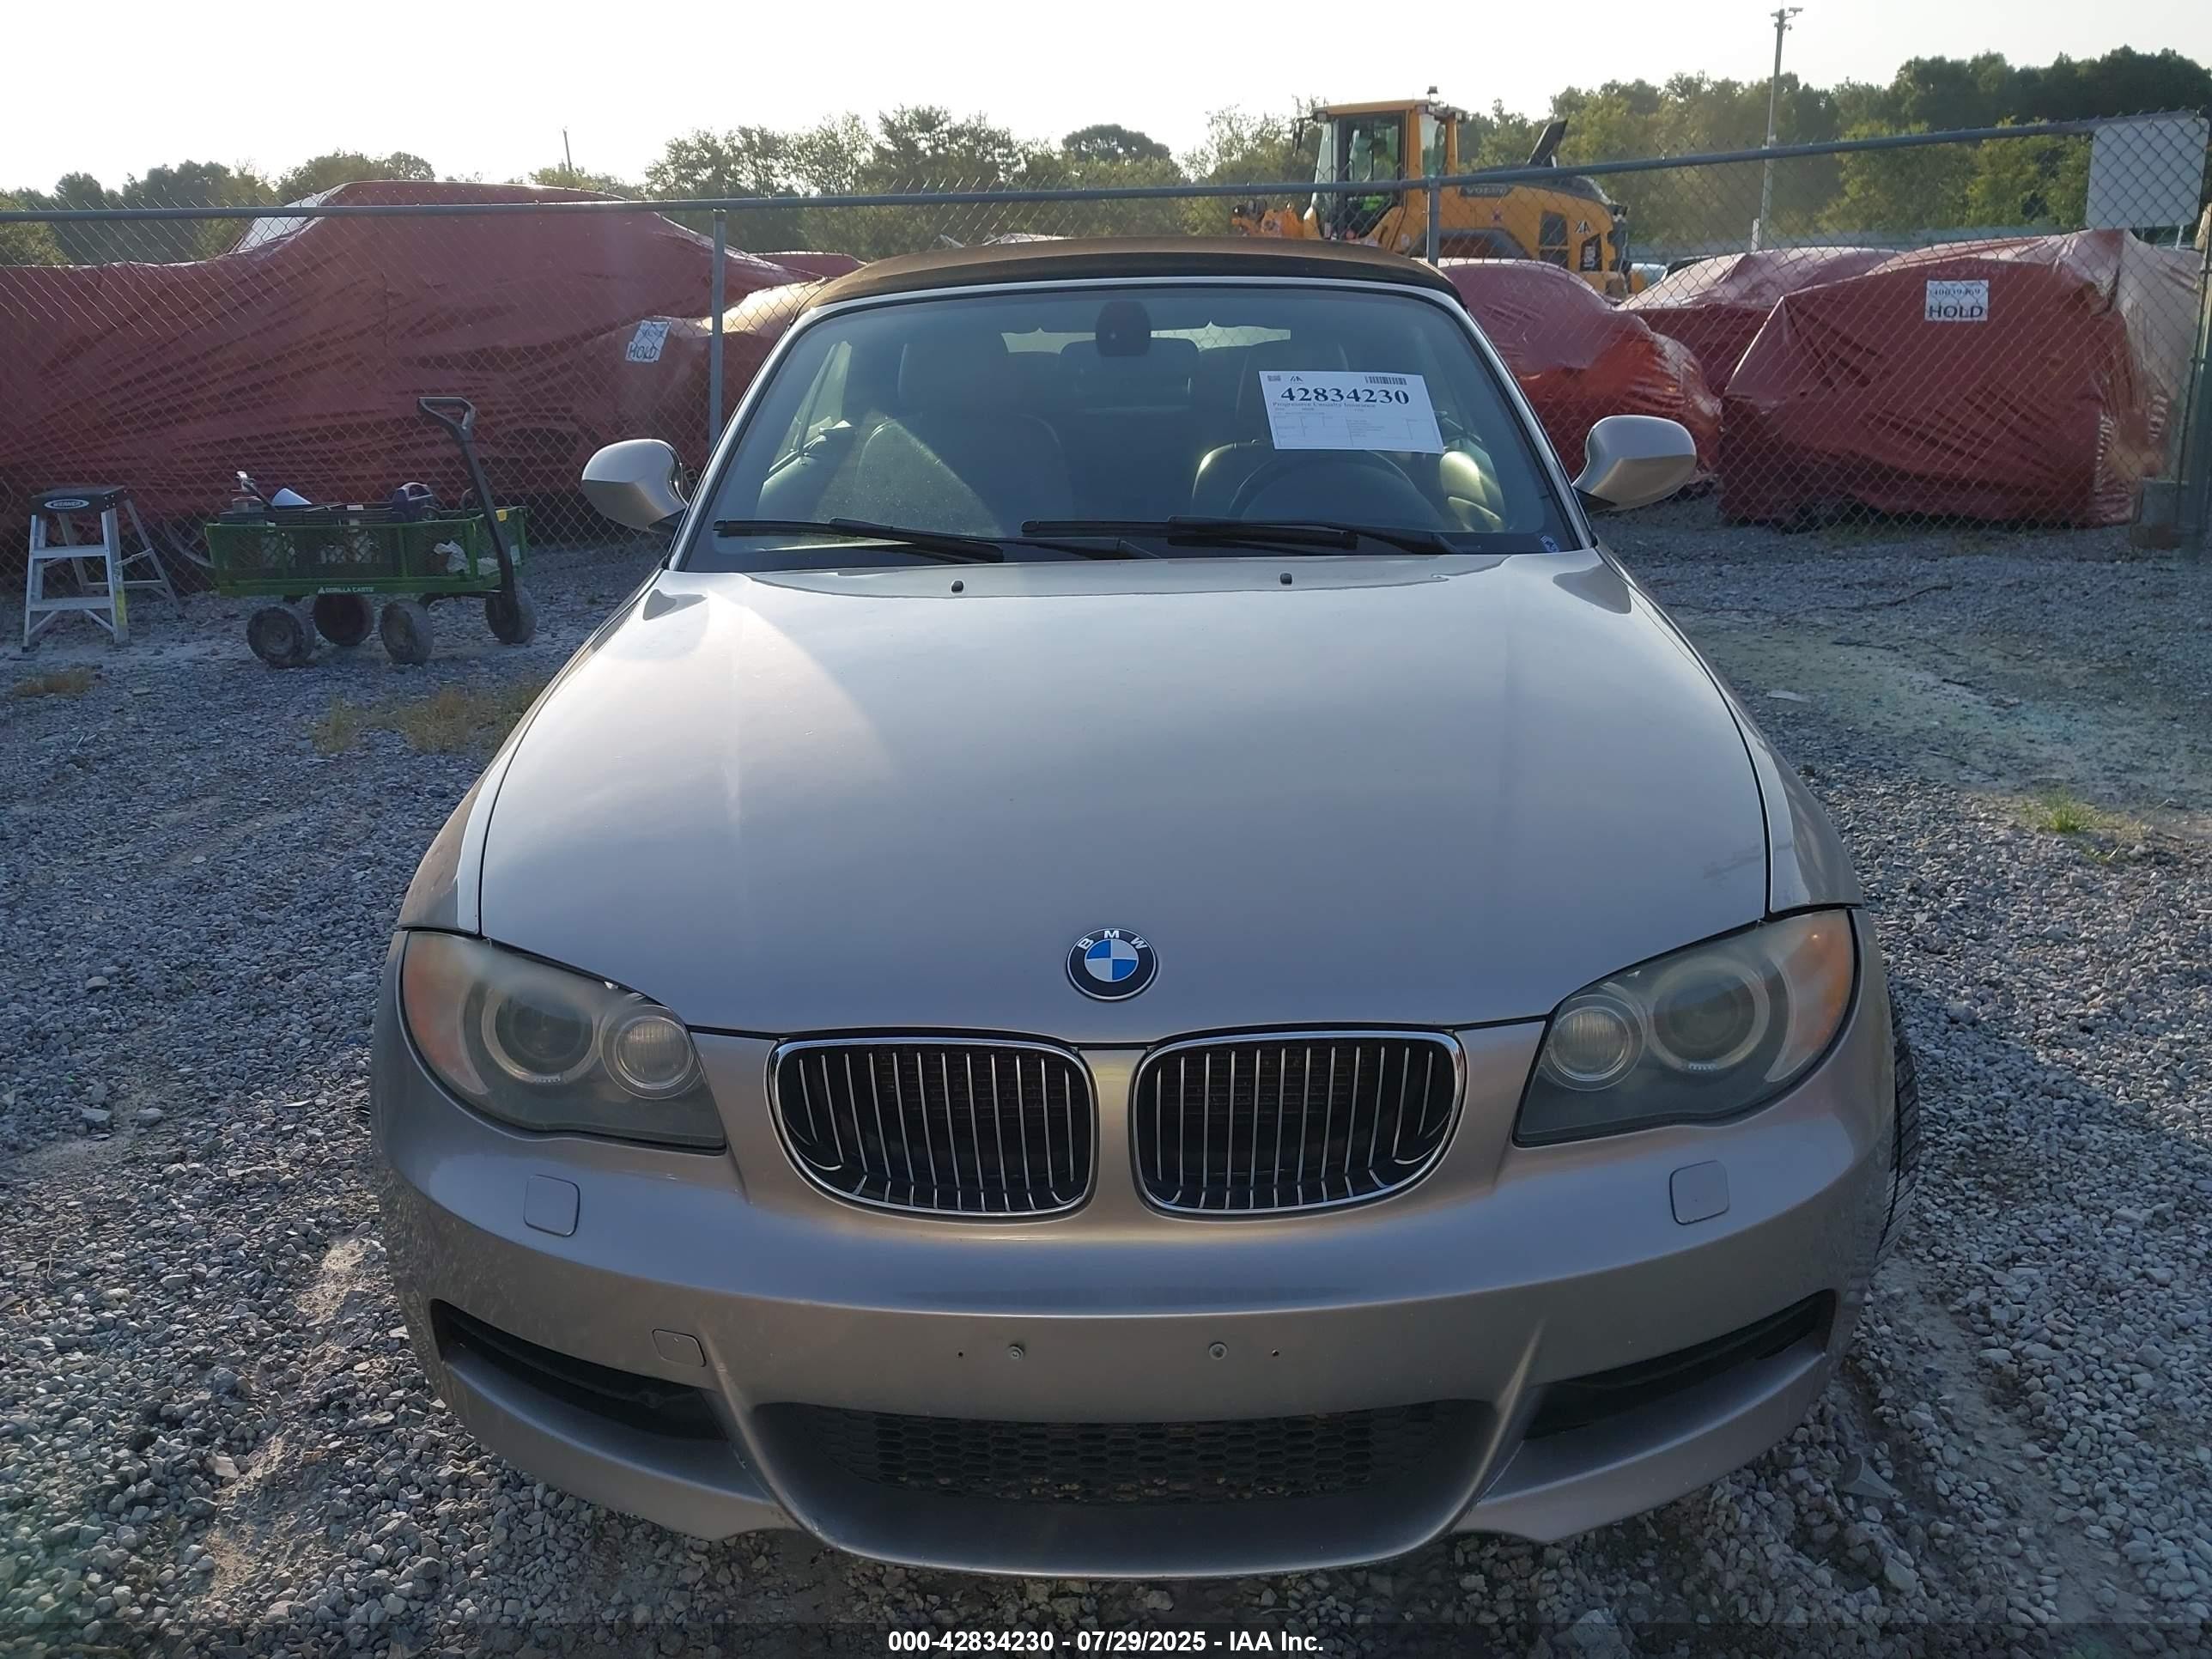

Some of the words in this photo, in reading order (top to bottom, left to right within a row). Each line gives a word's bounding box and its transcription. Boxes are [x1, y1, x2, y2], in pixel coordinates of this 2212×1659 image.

[1929, 305, 1984, 319] HOLD
[1280, 387, 1410, 404] 42834230
[1077, 930, 1148, 950] BMW
